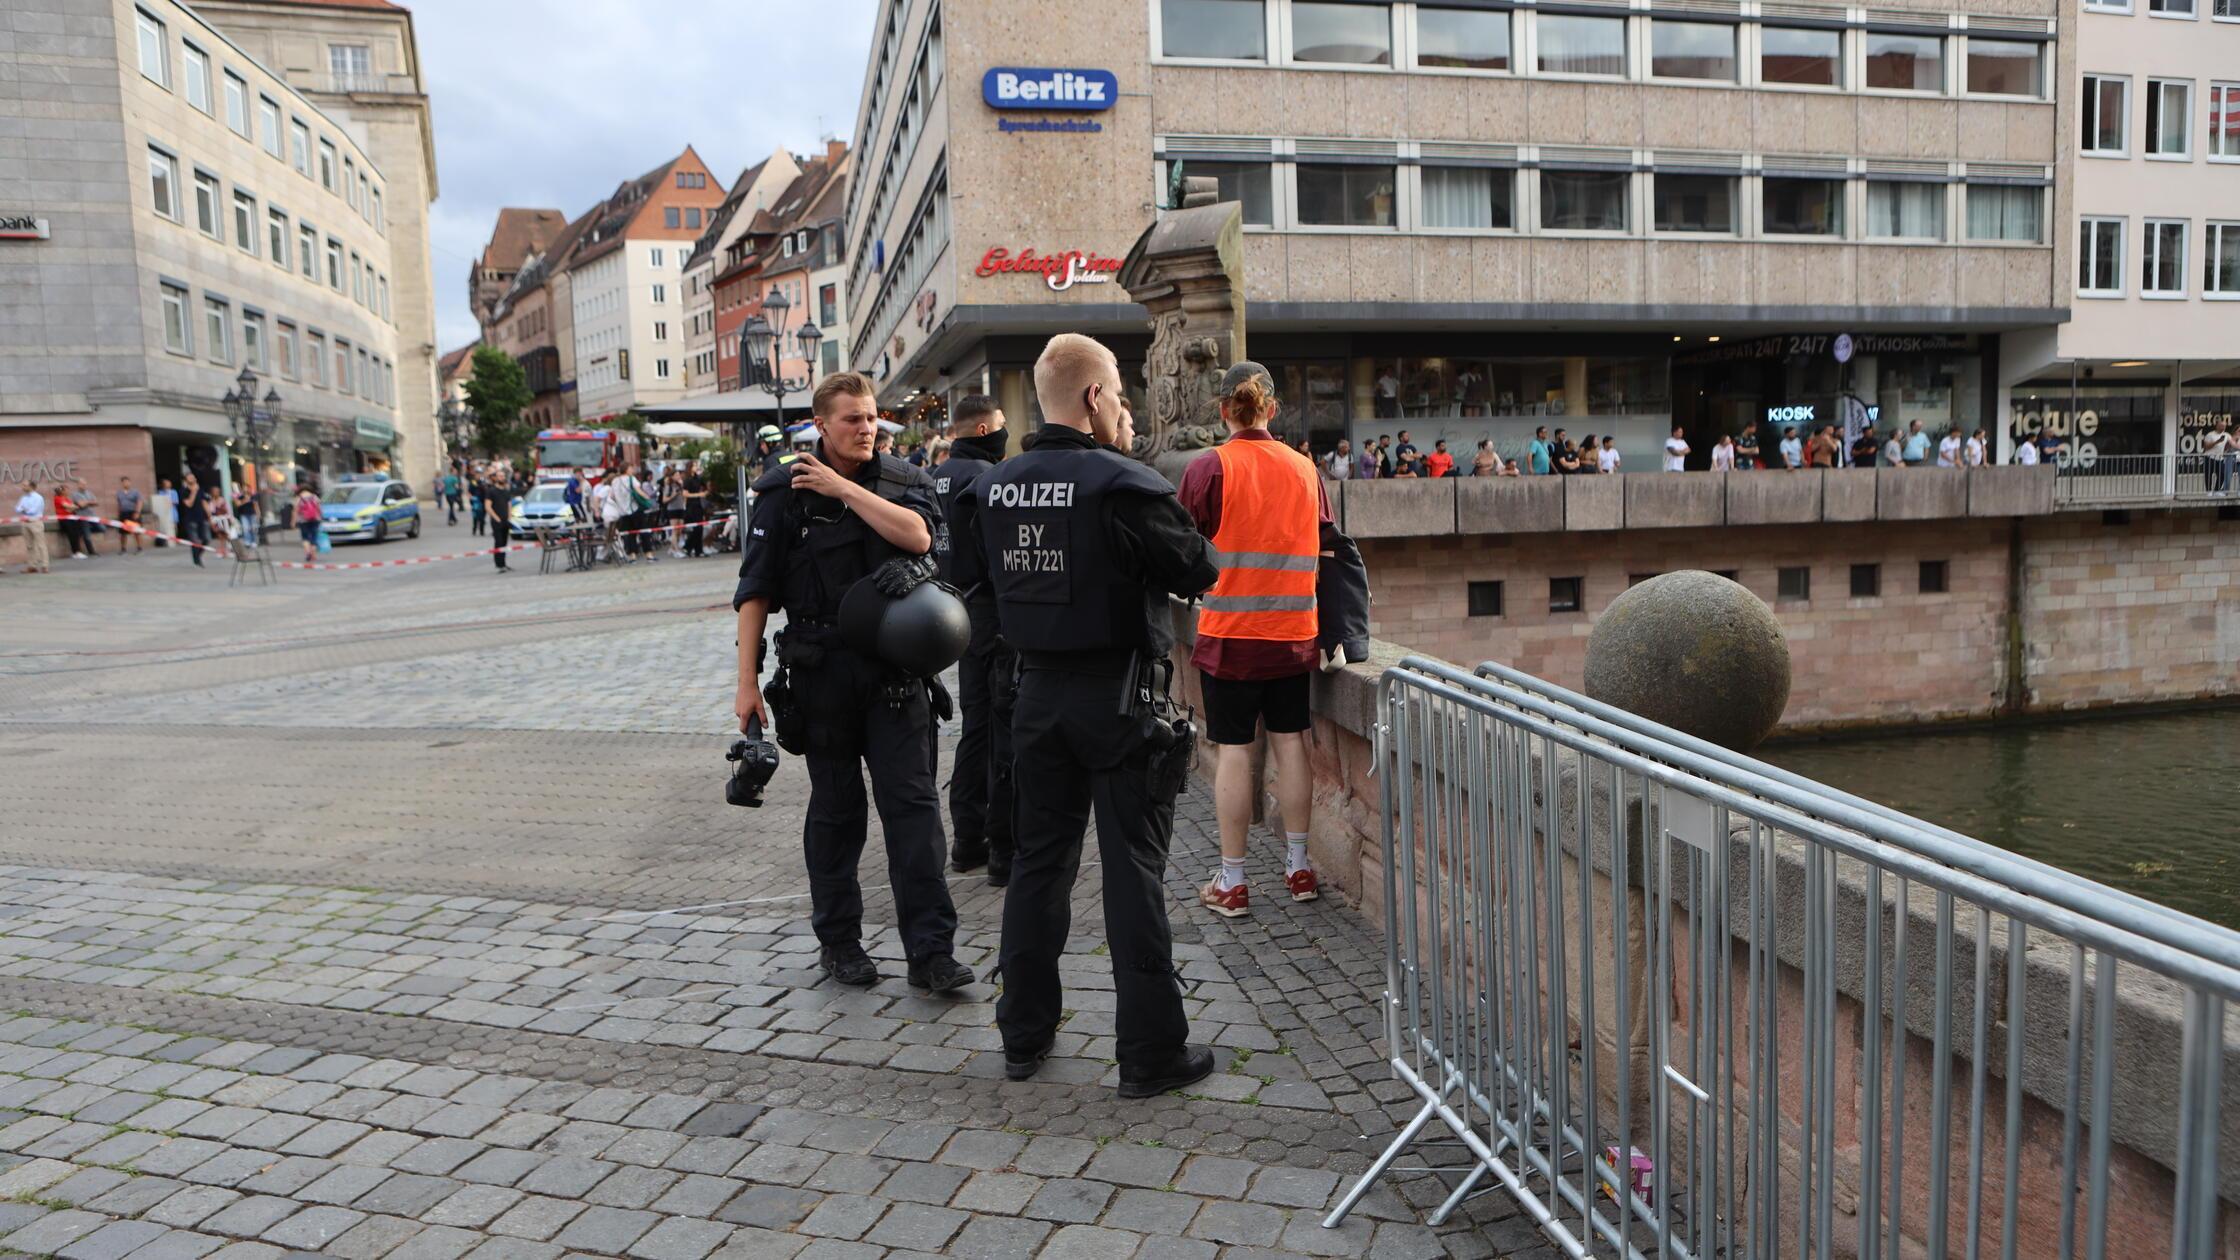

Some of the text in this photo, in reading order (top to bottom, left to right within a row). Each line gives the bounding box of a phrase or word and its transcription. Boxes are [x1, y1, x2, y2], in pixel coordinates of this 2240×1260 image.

[997, 73, 1105, 101] Berlitz
[1789, 335, 1828, 354] 24/7
[1768, 405, 1815, 422] KIOSK
[0, 460, 81, 483] ASSAGE
[988, 483, 1075, 508] POLIZEI
[1018, 524, 1045, 547] BY
[1003, 549, 1064, 572] MFR 7221
